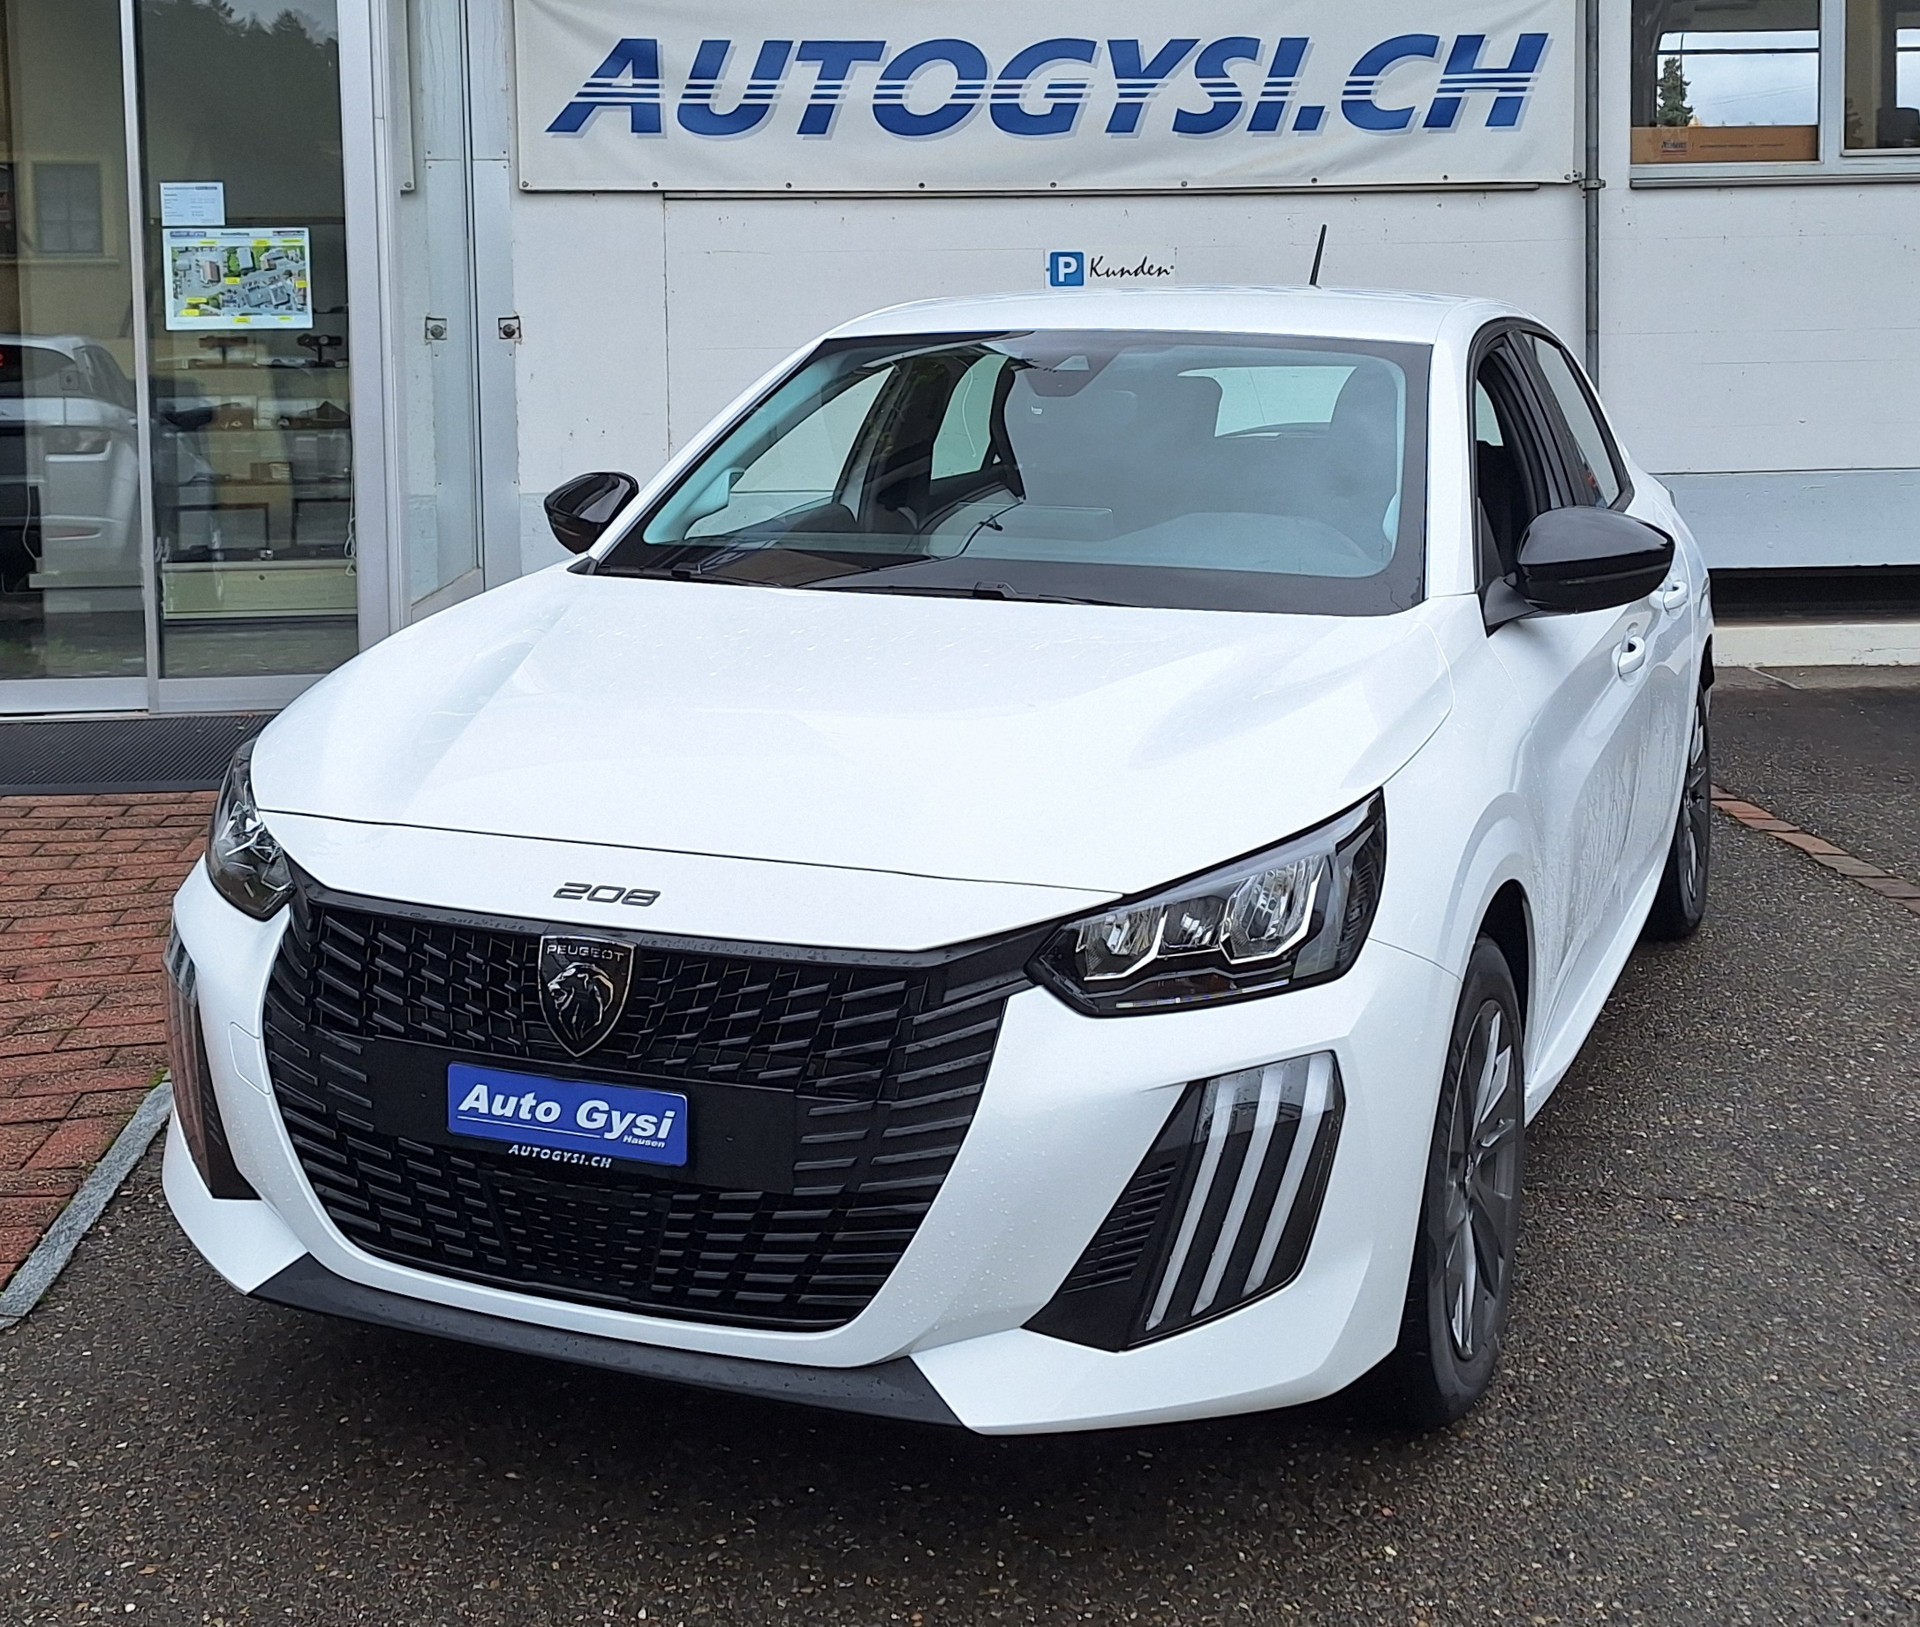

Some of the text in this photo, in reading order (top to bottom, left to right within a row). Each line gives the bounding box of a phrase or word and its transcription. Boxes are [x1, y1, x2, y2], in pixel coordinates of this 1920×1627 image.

[545, 33, 1551, 138] AUTOGYSI.CH
[1056, 255, 1171, 283] P Kunden
[553, 882, 661, 907] 208
[546, 944, 625, 962] PEUGEOT
[458, 1084, 676, 1140] Auto Gysi
[622, 1134, 666, 1149] Hausen
[508, 1144, 613, 1169] AUTOGYSI.CH
